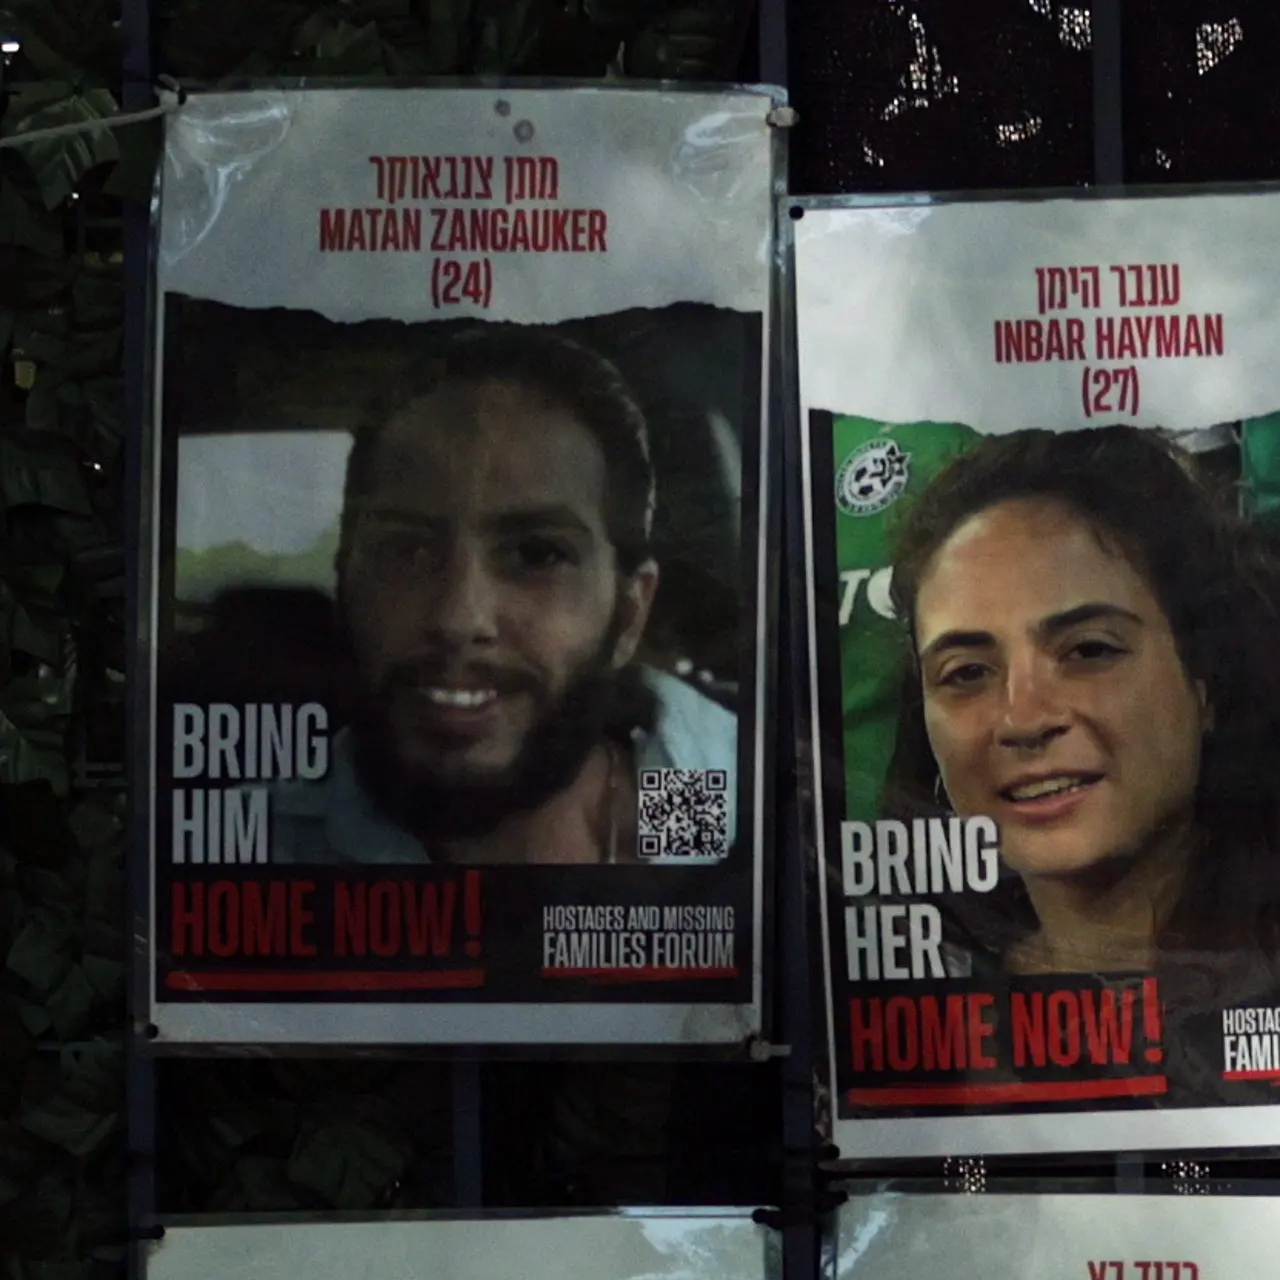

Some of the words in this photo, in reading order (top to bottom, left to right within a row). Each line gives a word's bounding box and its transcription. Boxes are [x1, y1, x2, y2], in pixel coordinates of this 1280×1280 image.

[369, 157, 492, 203] צנגאוקר
[505, 157, 557, 202] מתן
[320, 210, 420, 251] MATAN
[431, 209, 606, 251] ZANGAUKER
[431, 260, 491, 306] (24)
[1036, 267, 1099, 314] הימן
[1112, 265, 1179, 308] ענבר
[995, 318, 1085, 361] INBAR
[1097, 315, 1223, 358] HAYMAN
[1082, 367, 1138, 414] (27)
[842, 816, 998, 897] BRING
[543, 907, 624, 930] HOSTAGES
[626, 907, 659, 930] AND
[662, 907, 734, 930] MISSING
[543, 934, 645, 968] FAMILIES
[652, 934, 734, 968] FORUM
[844, 903, 945, 982] HER
[852, 993, 997, 1073] HOME
[1012, 977, 1165, 1068] NOW!
